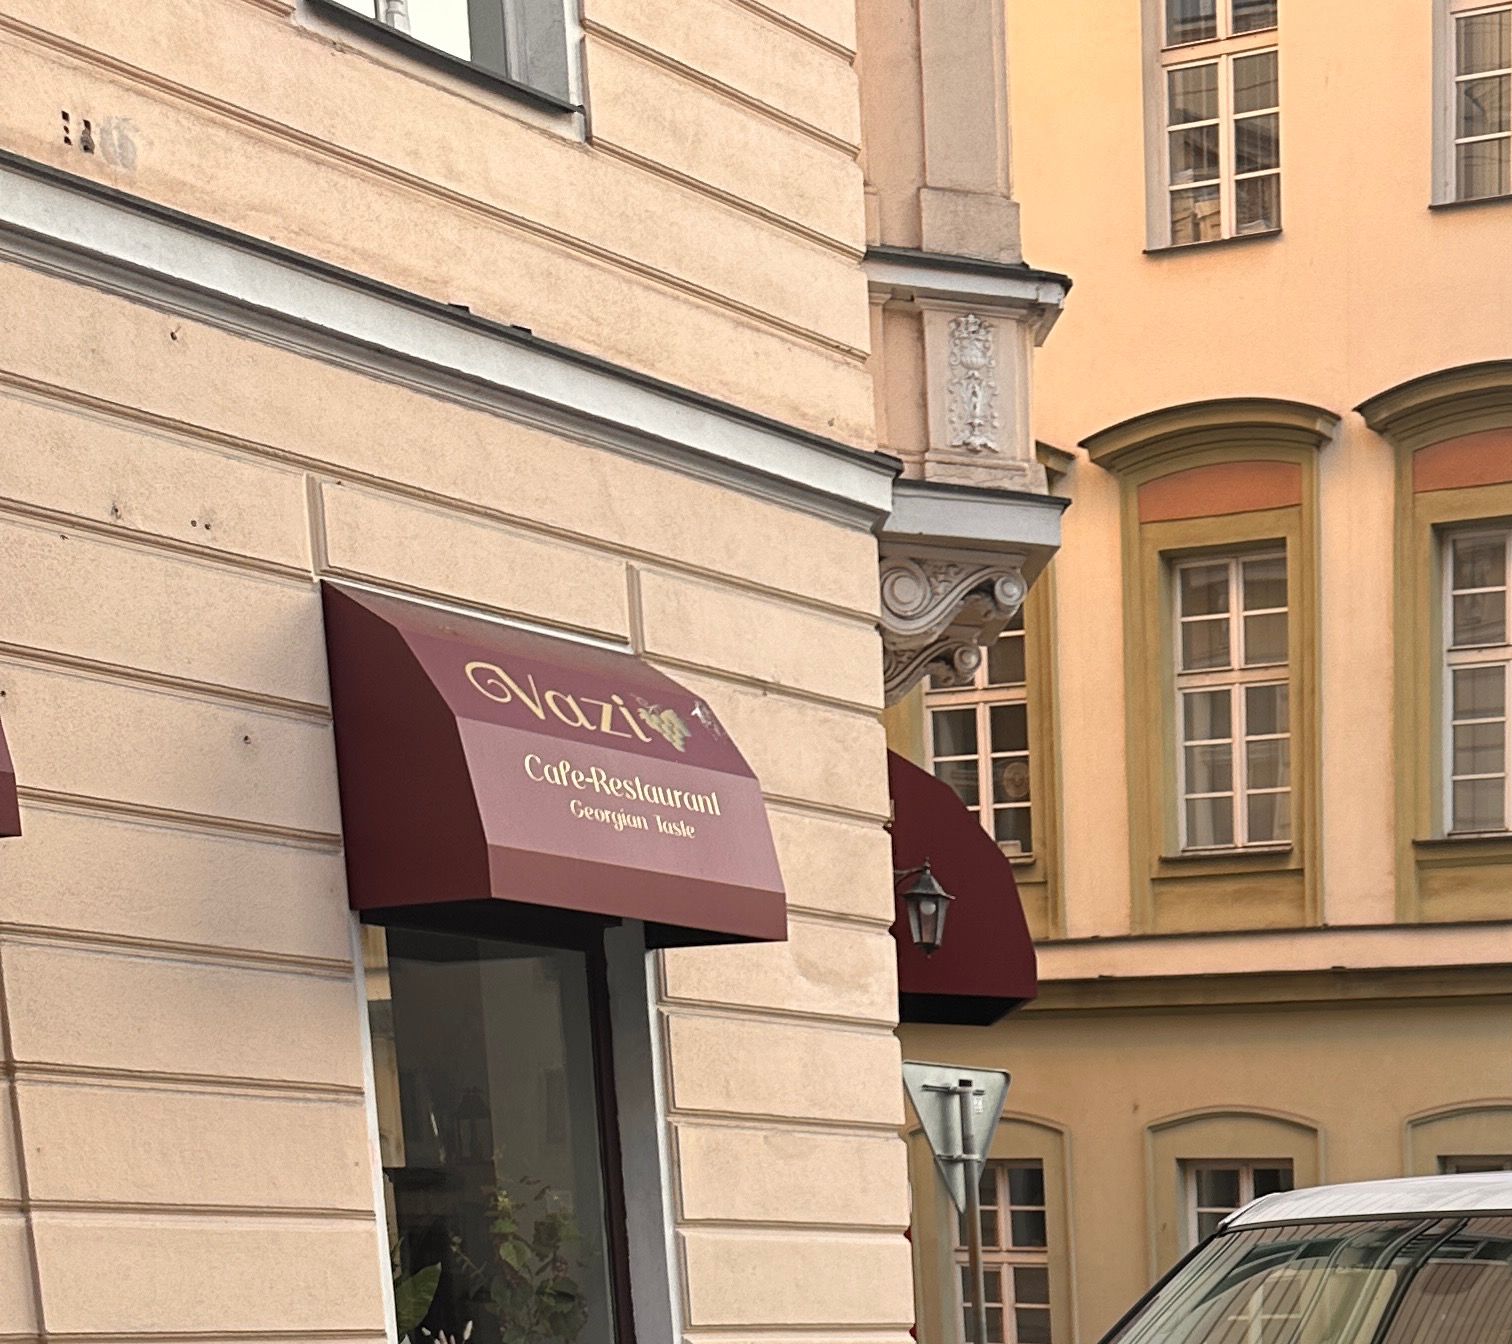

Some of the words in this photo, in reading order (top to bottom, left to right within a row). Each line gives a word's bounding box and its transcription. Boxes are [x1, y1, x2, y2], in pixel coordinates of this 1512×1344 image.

[465, 661, 652, 743] Vazi
[524, 754, 721, 816] Cafe-Restaurant
[570, 800, 648, 832] Georgian
[655, 815, 695, 839] Taste
